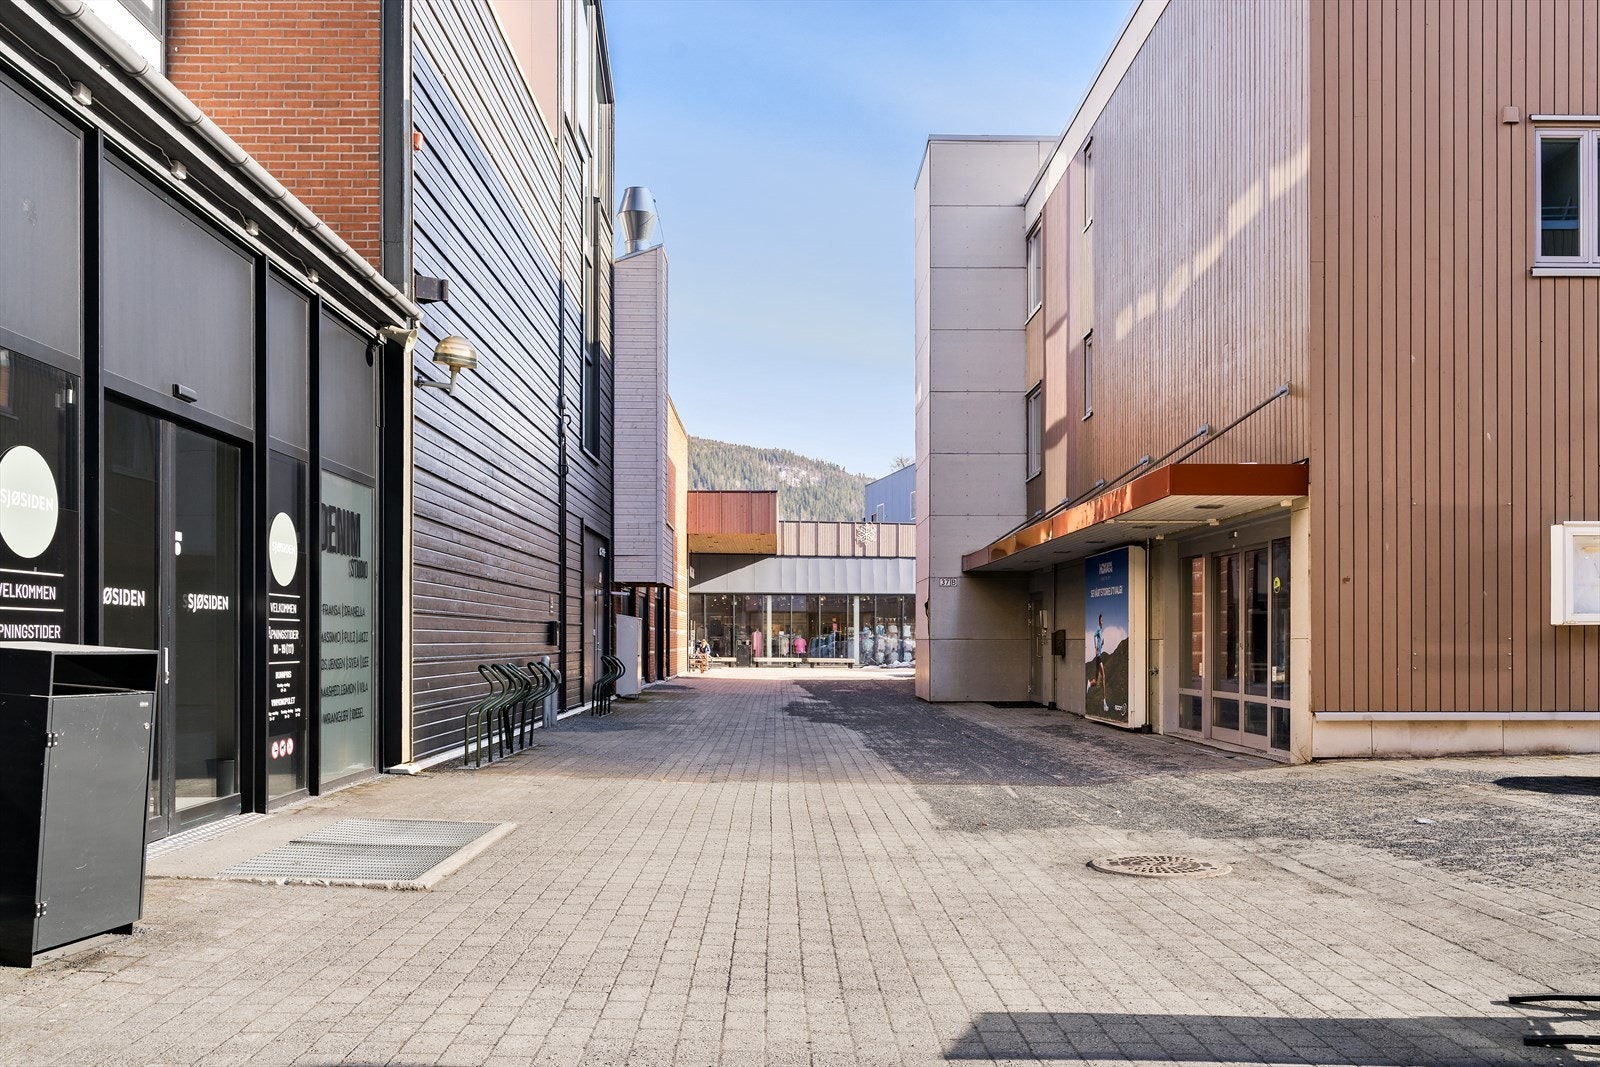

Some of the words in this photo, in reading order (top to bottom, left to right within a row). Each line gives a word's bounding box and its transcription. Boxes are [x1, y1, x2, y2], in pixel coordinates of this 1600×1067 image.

[0, 488, 54, 512] SJØSIDEN
[321, 502, 361, 558] DENIM
[187, 593, 229, 613] SJØSIDEN
[270, 602, 297, 614] VELKOMMEN
